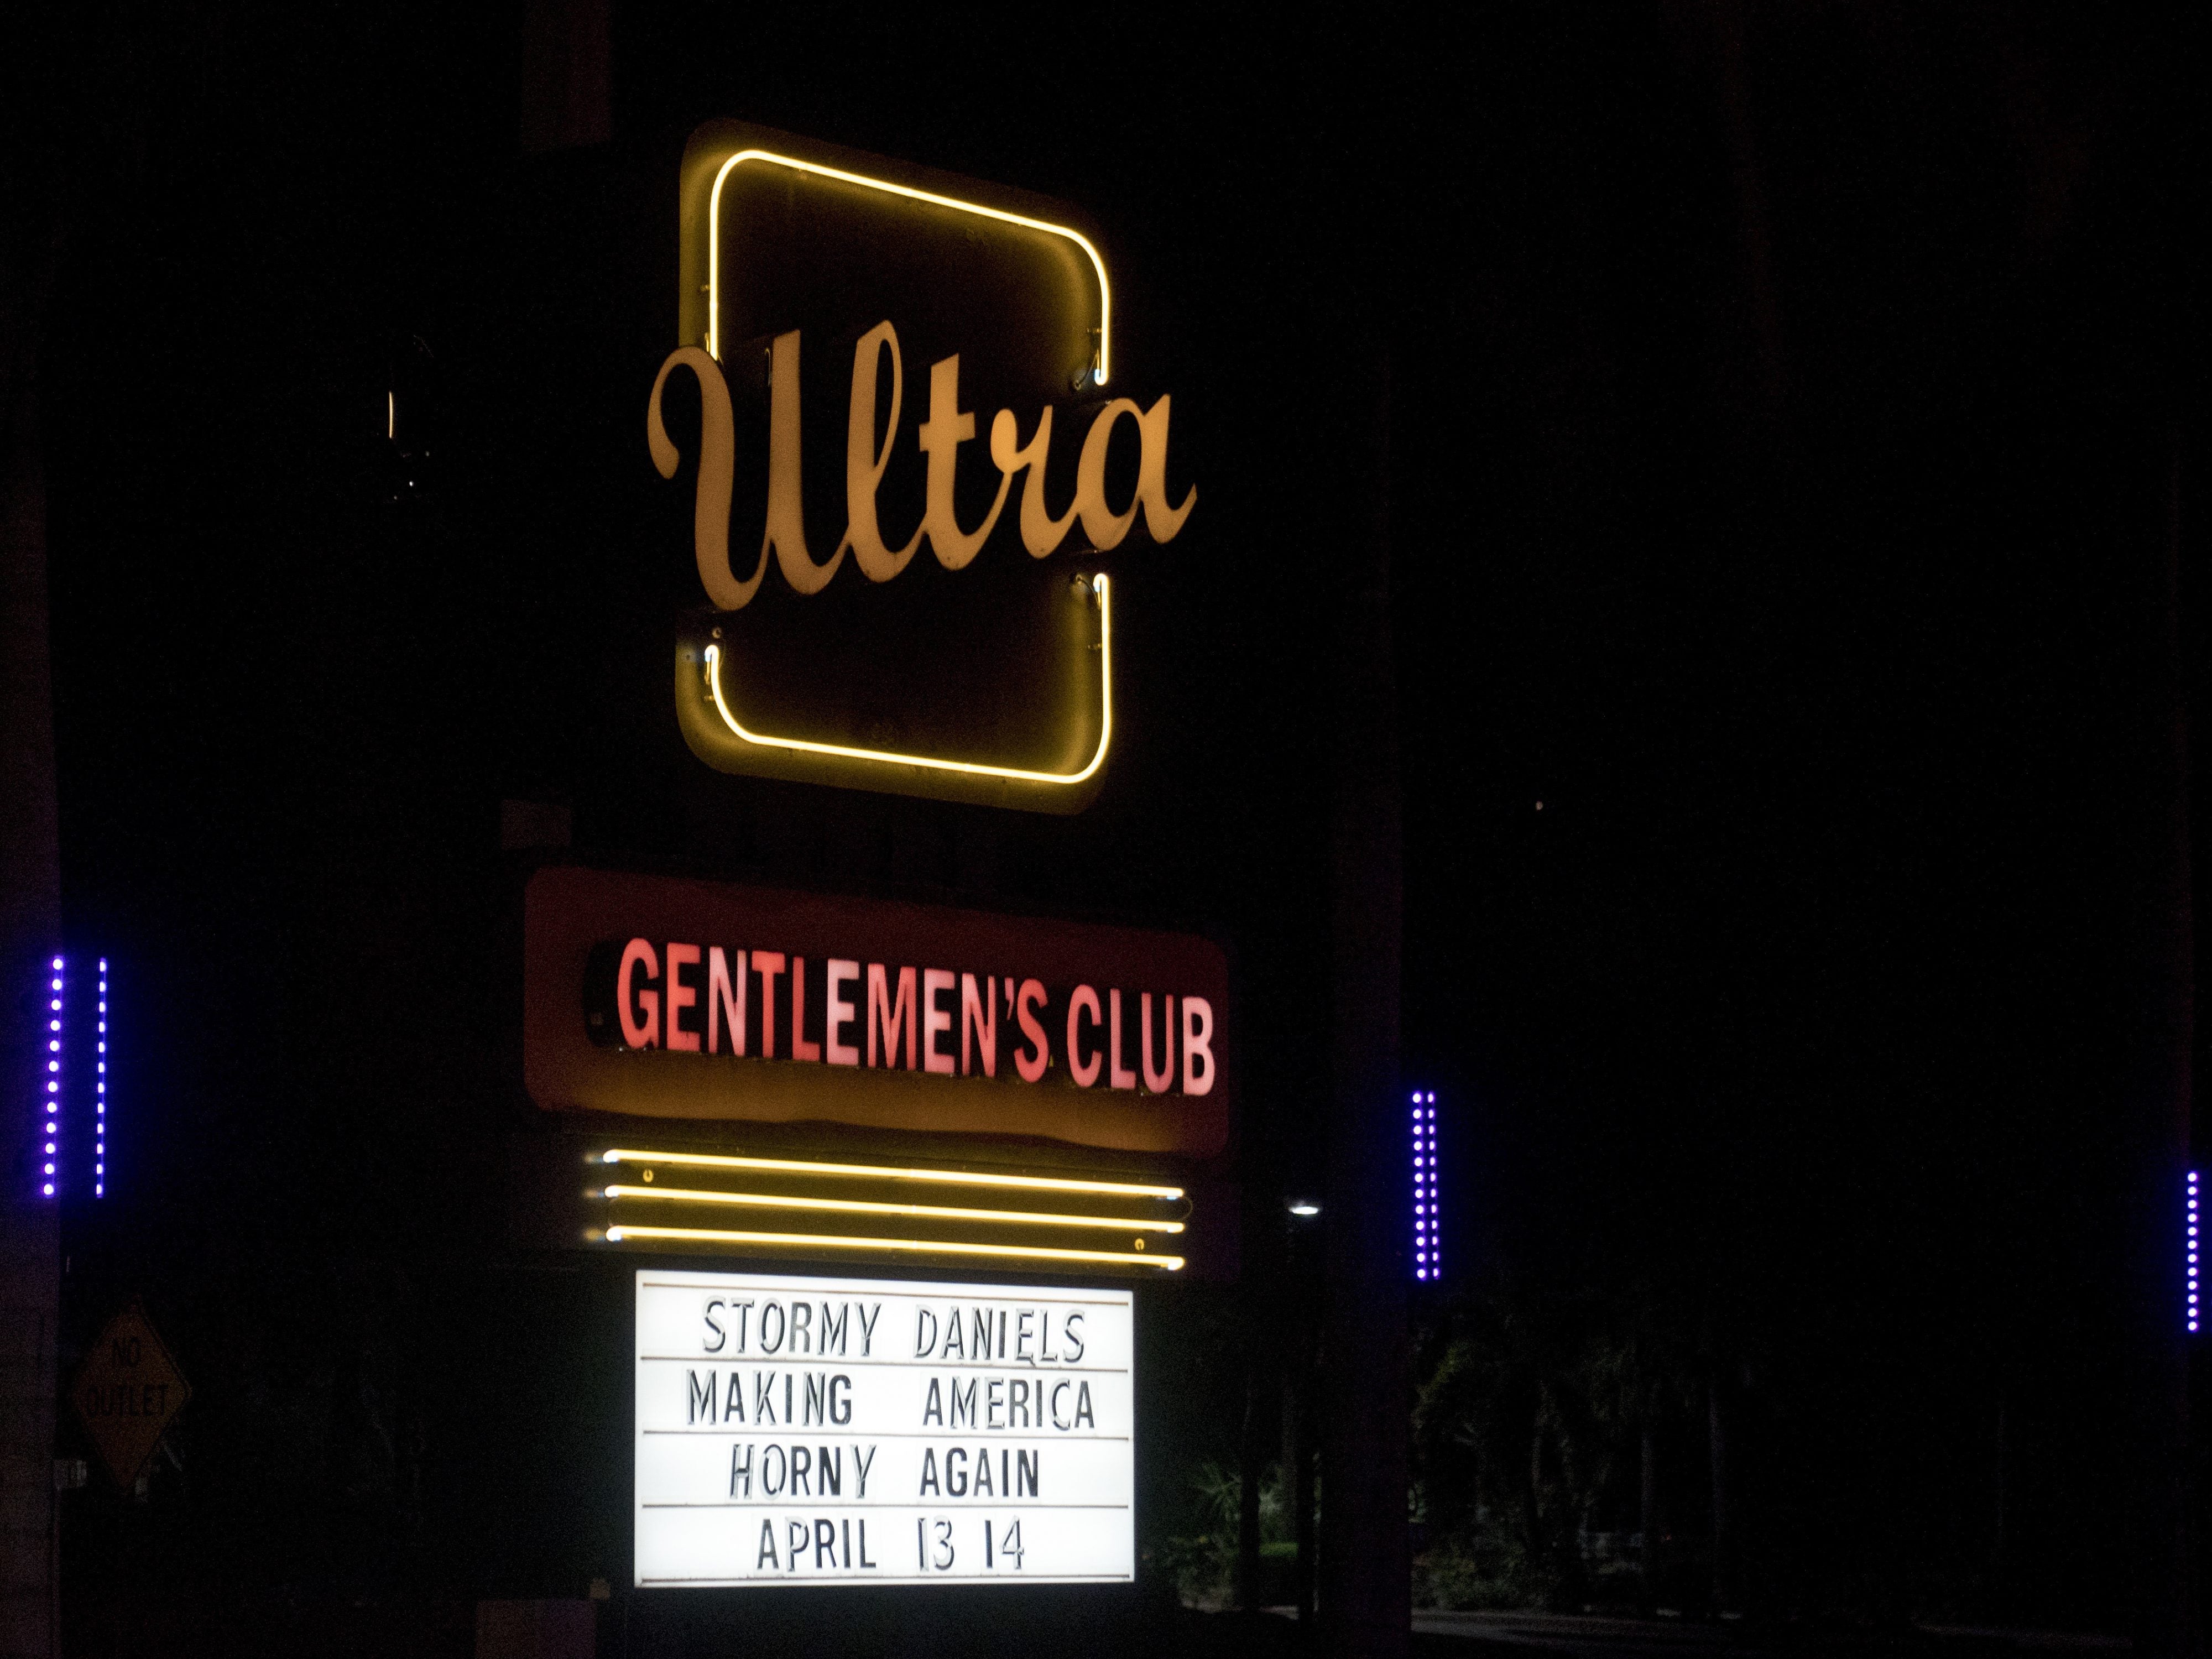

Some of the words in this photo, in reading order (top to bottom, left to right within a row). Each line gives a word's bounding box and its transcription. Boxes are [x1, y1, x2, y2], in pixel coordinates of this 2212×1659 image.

[648, 320, 1198, 611] Ultra
[617, 938, 1049, 1083] GENTLEMEN'S
[1067, 984, 1215, 1097] CLUB
[113, 1337, 140, 1365] NO
[702, 1296, 882, 1357] STORMY
[914, 1304, 1086, 1363] DANIELS
[87, 1385, 168, 1416] OUTLET
[686, 1369, 852, 1427] MAKING
[922, 1375, 1095, 1431] AMERICA
[730, 1444, 877, 1500] HORNY
[919, 1447, 1039, 1498] AGAIN
[757, 1517, 877, 1572] APRIL
[918, 1515, 954, 1572] 13
[984, 1515, 1025, 1571] 14
